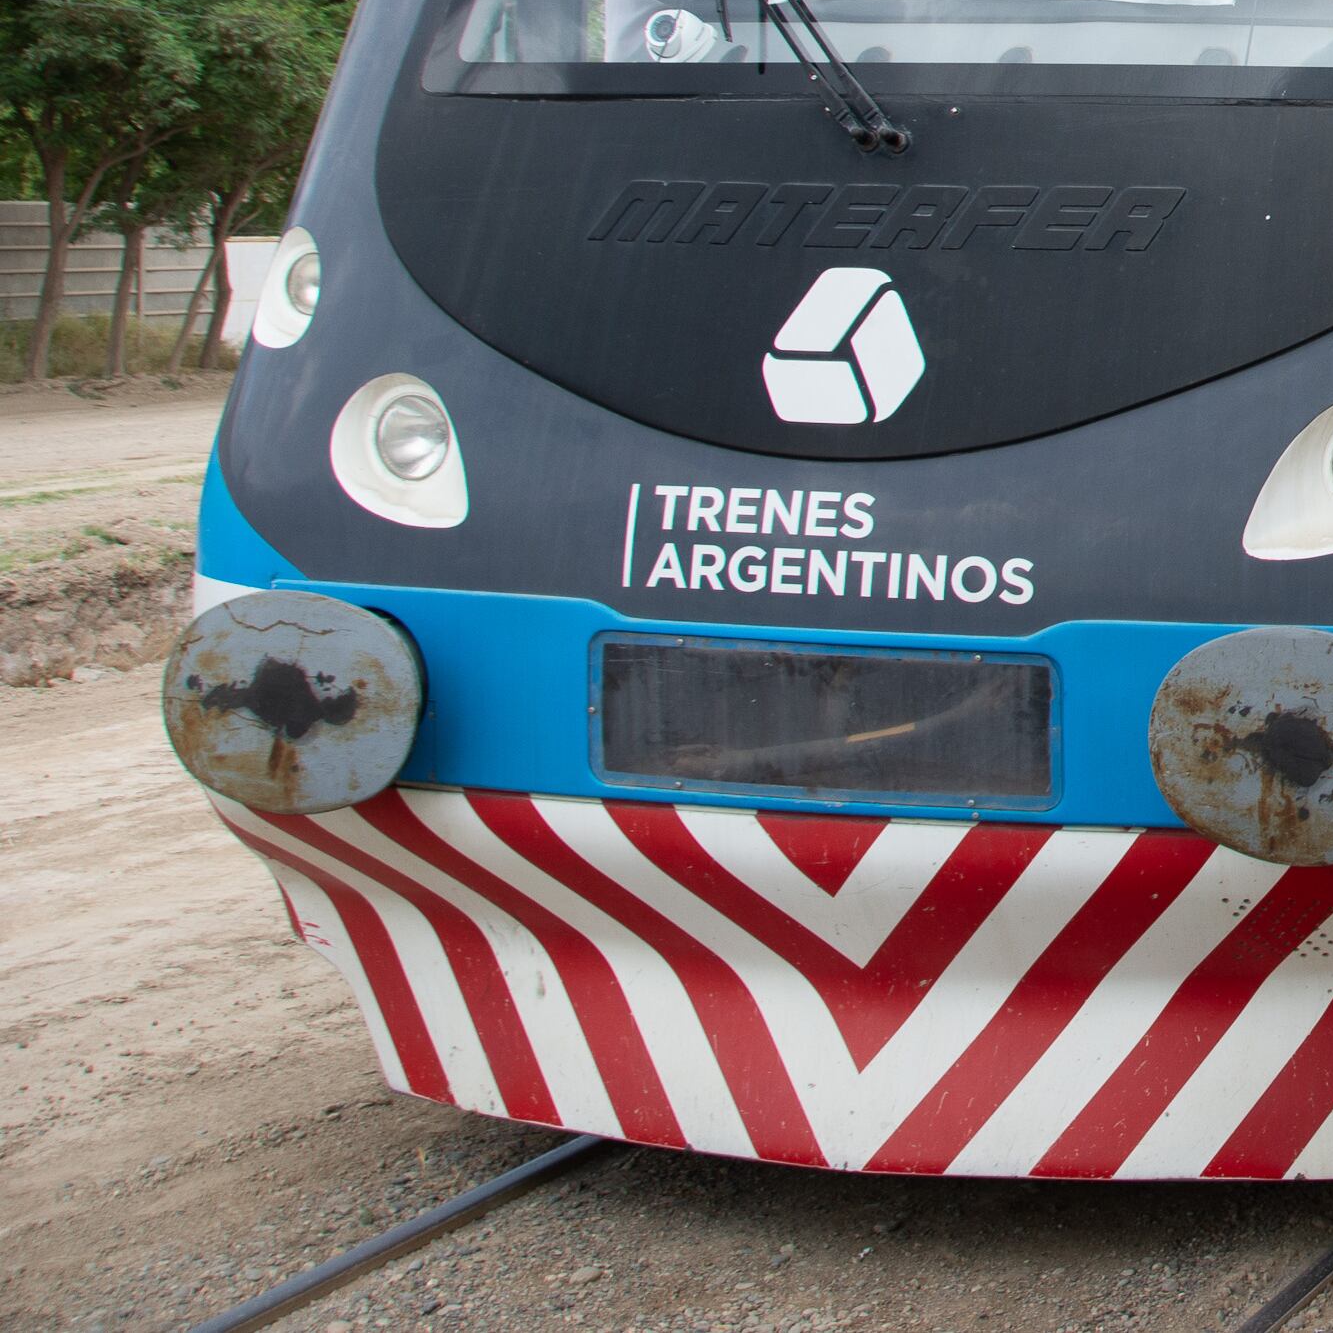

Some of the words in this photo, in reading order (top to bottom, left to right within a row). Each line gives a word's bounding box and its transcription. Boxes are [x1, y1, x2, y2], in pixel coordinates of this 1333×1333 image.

[588, 179, 1188, 252] MATERFER
[654, 484, 876, 539] TRENES
[645, 542, 1035, 606] ARGENTINOS
